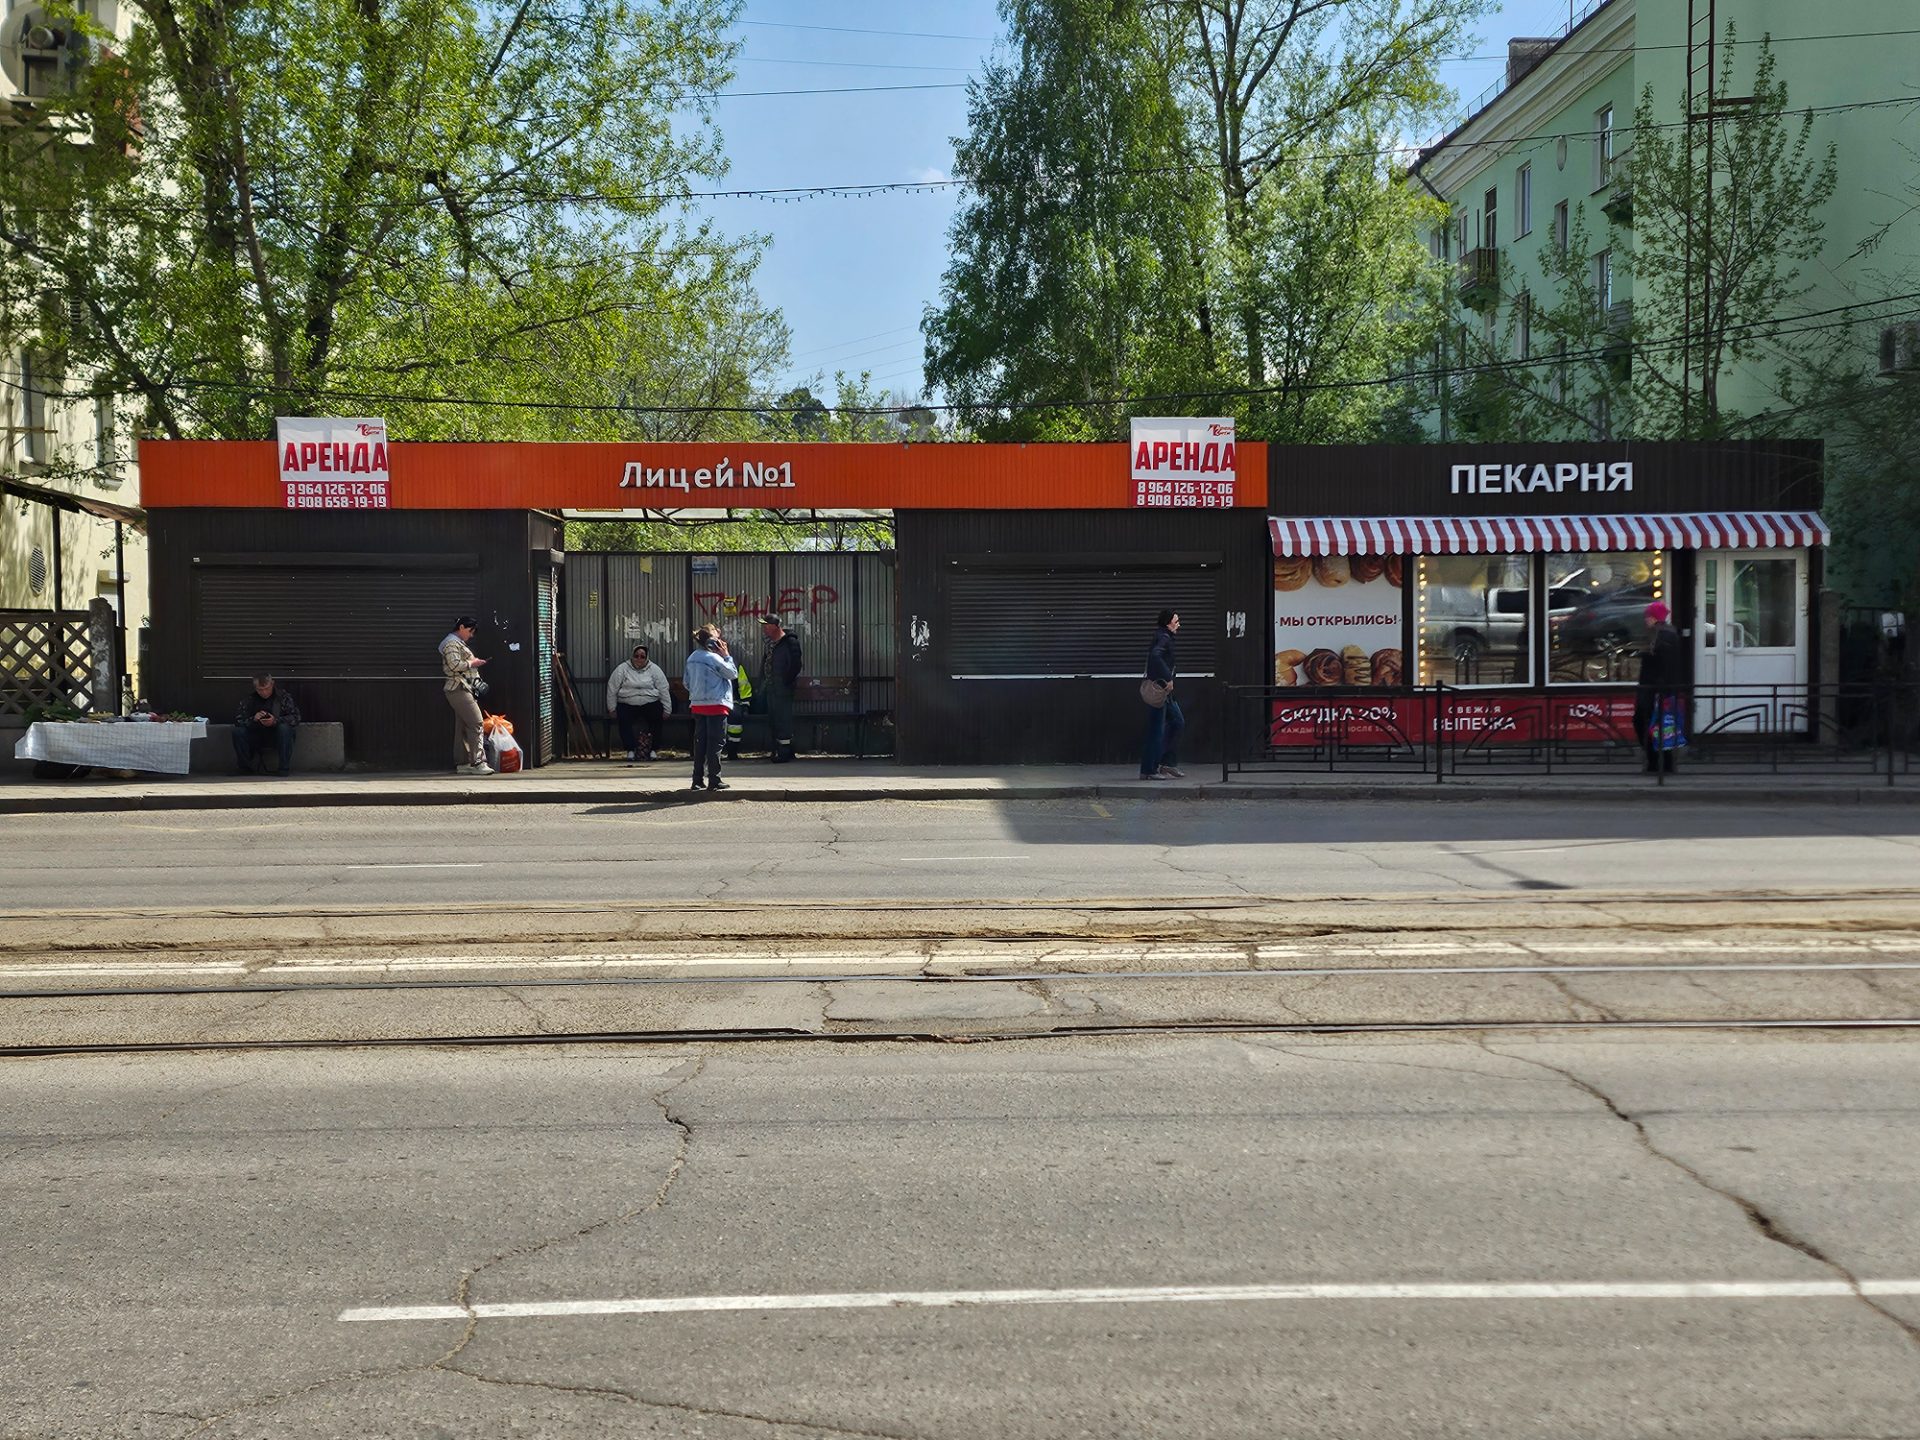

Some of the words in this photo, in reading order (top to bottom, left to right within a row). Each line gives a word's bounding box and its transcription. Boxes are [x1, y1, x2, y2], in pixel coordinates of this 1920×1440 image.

[283, 442, 388, 474] АРЕНДА
[1135, 441, 1236, 474] АРЕНДА
[619, 457, 734, 493] Лицей
[742, 461, 796, 488] №1
[1451, 462, 1633, 494] ПЕКАРНЯ
[287, 483, 296, 495] 8
[298, 483, 323, 495] 964
[324, 483, 386, 496] 126-12-06
[1137, 481, 1146, 493] 8
[1148, 482, 1172, 494] 964
[1174, 482, 1234, 495] 126-12-06
[287, 496, 296, 508] 8
[298, 496, 323, 508] 908
[325, 496, 387, 508] 658-19-19
[1137, 494, 1145, 506] 8
[1147, 494, 1172, 506] 908
[1173, 495, 1234, 507] 658-19-19
[1279, 616, 1304, 627] МЫ
[1306, 614, 1397, 626] ОТКРЫЛИСЬ!
[1280, 707, 1356, 724] СКИДКА
[1358, 706, 1398, 721] 20%
[1433, 716, 1517, 731] ВЫПЕЧКА
